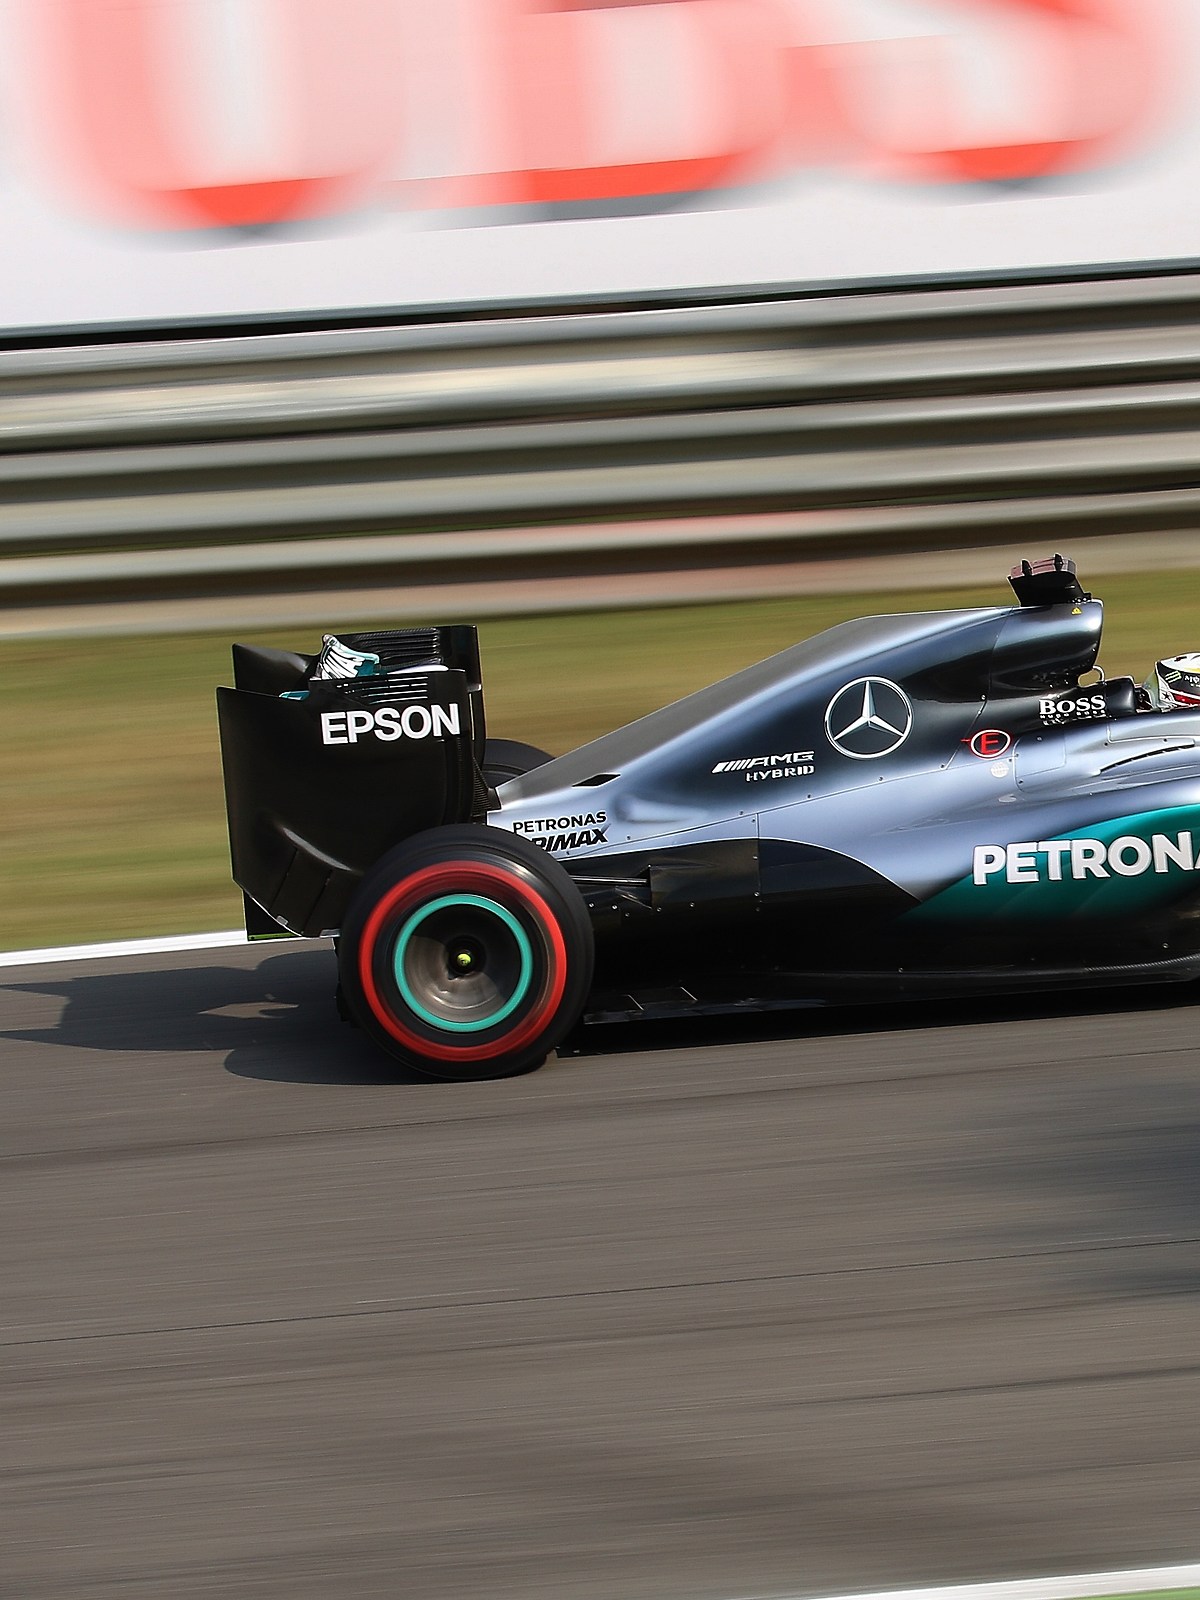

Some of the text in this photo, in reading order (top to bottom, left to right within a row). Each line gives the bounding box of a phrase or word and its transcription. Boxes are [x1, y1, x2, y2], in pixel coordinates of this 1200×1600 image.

[1039, 694, 1106, 715] BOSS
[320, 703, 461, 745] EPSON
[746, 765, 815, 782] HYBRID
[513, 811, 607, 834] PETRONAS
[531, 828, 608, 852] RIMAX
